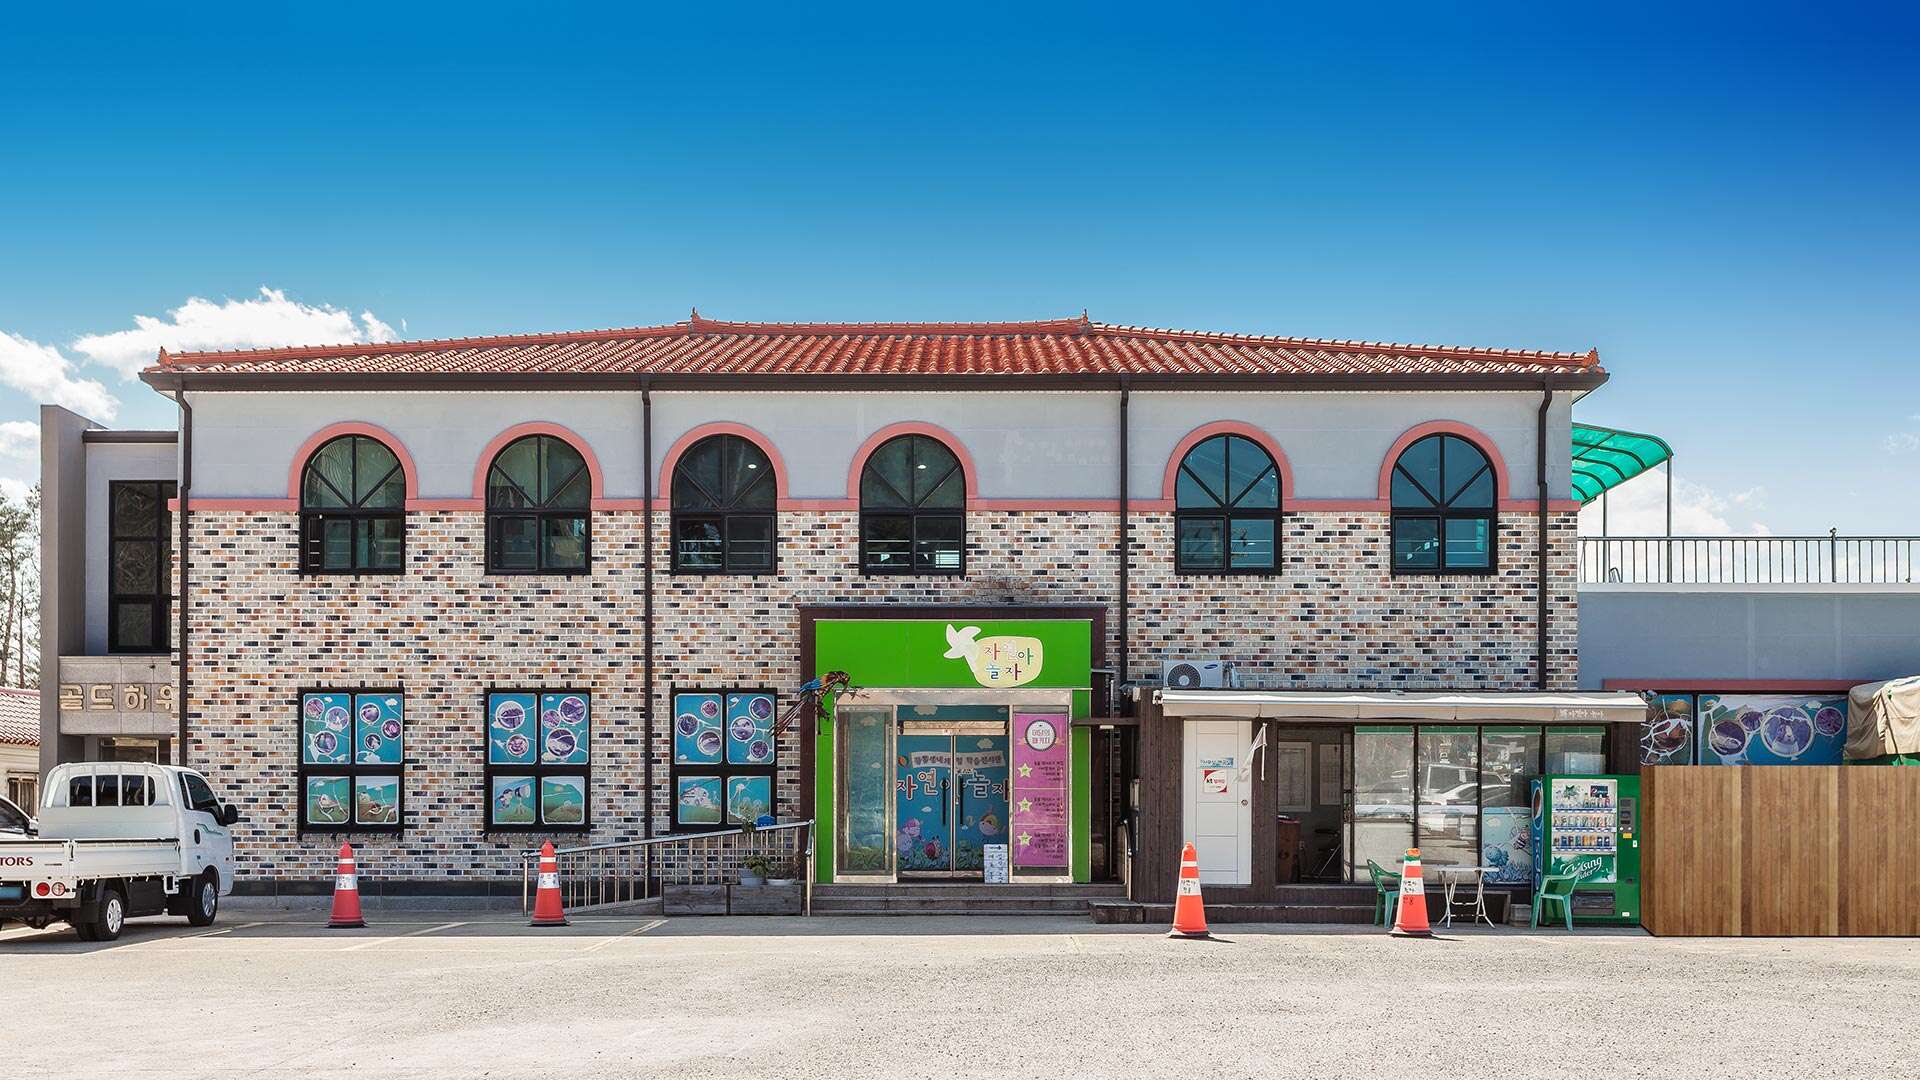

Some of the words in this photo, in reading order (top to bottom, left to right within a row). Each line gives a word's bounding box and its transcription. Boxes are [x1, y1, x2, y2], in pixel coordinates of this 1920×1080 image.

[983, 641, 1034, 665] 자연아
[985, 663, 1022, 681] 놀자
[0, 856, 33, 866] TORS
